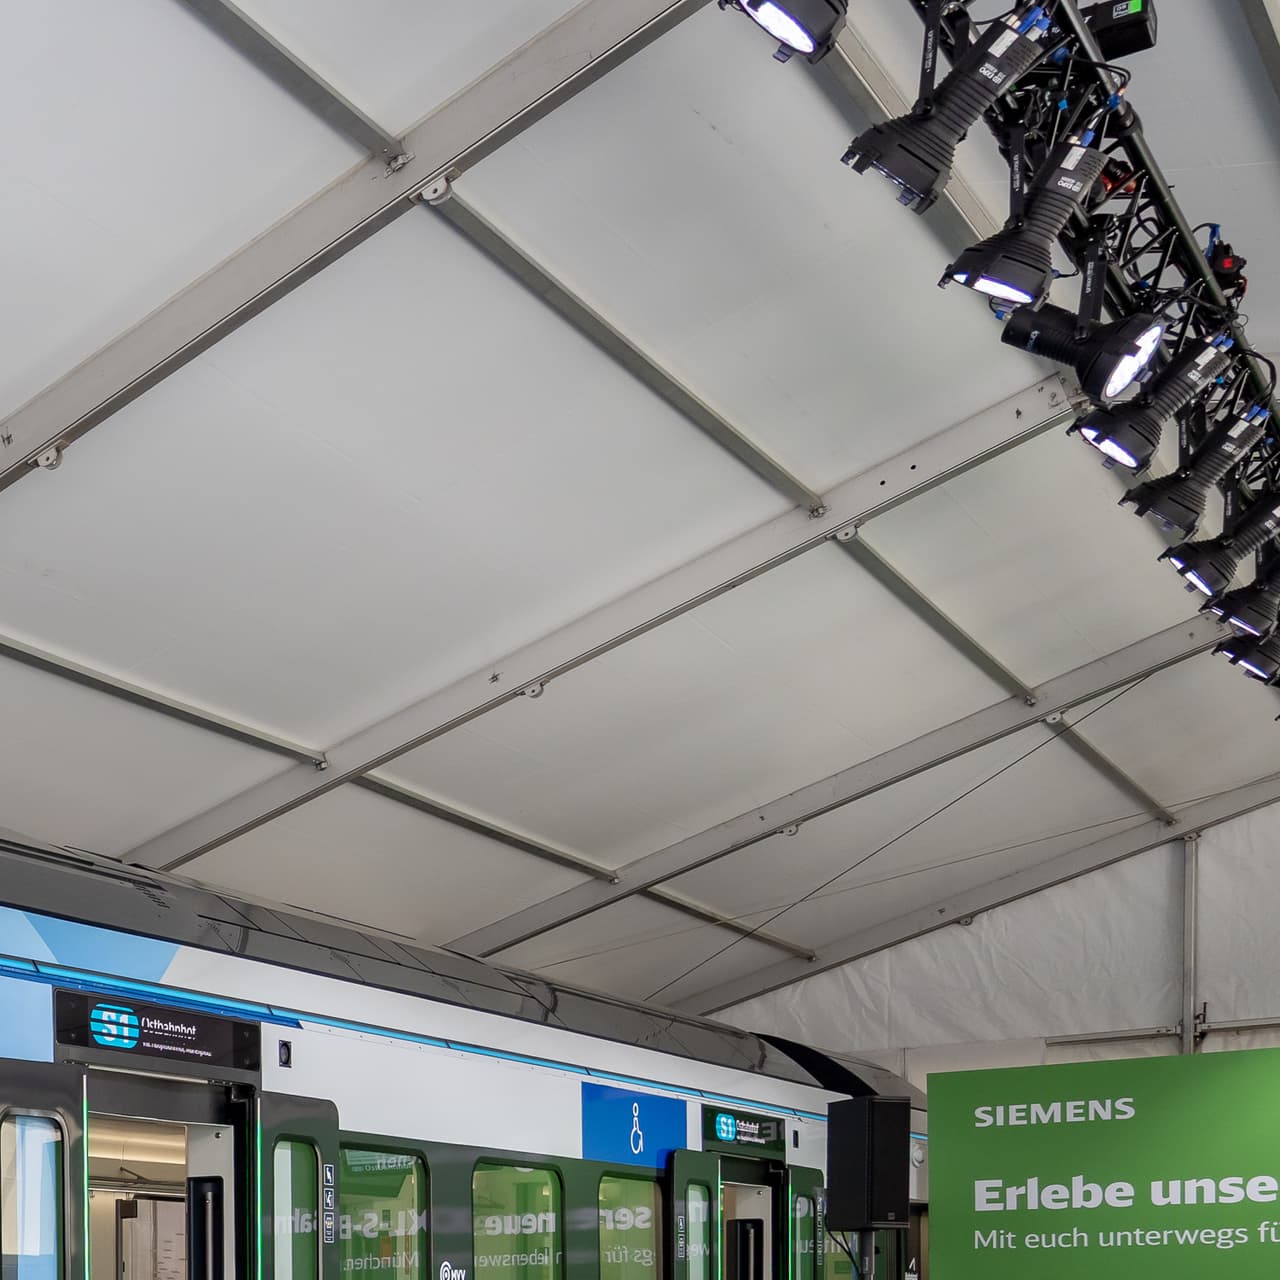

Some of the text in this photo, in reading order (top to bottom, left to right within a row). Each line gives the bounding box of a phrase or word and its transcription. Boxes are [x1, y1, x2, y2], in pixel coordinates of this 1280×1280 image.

[101, 1010, 130, 1044] S1
[720, 1116, 733, 1138] S1
[974, 1097, 1136, 1128] SIEMENS
[974, 1174, 1279, 1212] Erlebe unse
[974, 1229, 1017, 1249] Mit
[1025, 1226, 1088, 1249] euch
[1098, 1225, 1249, 1249] unterwegs
